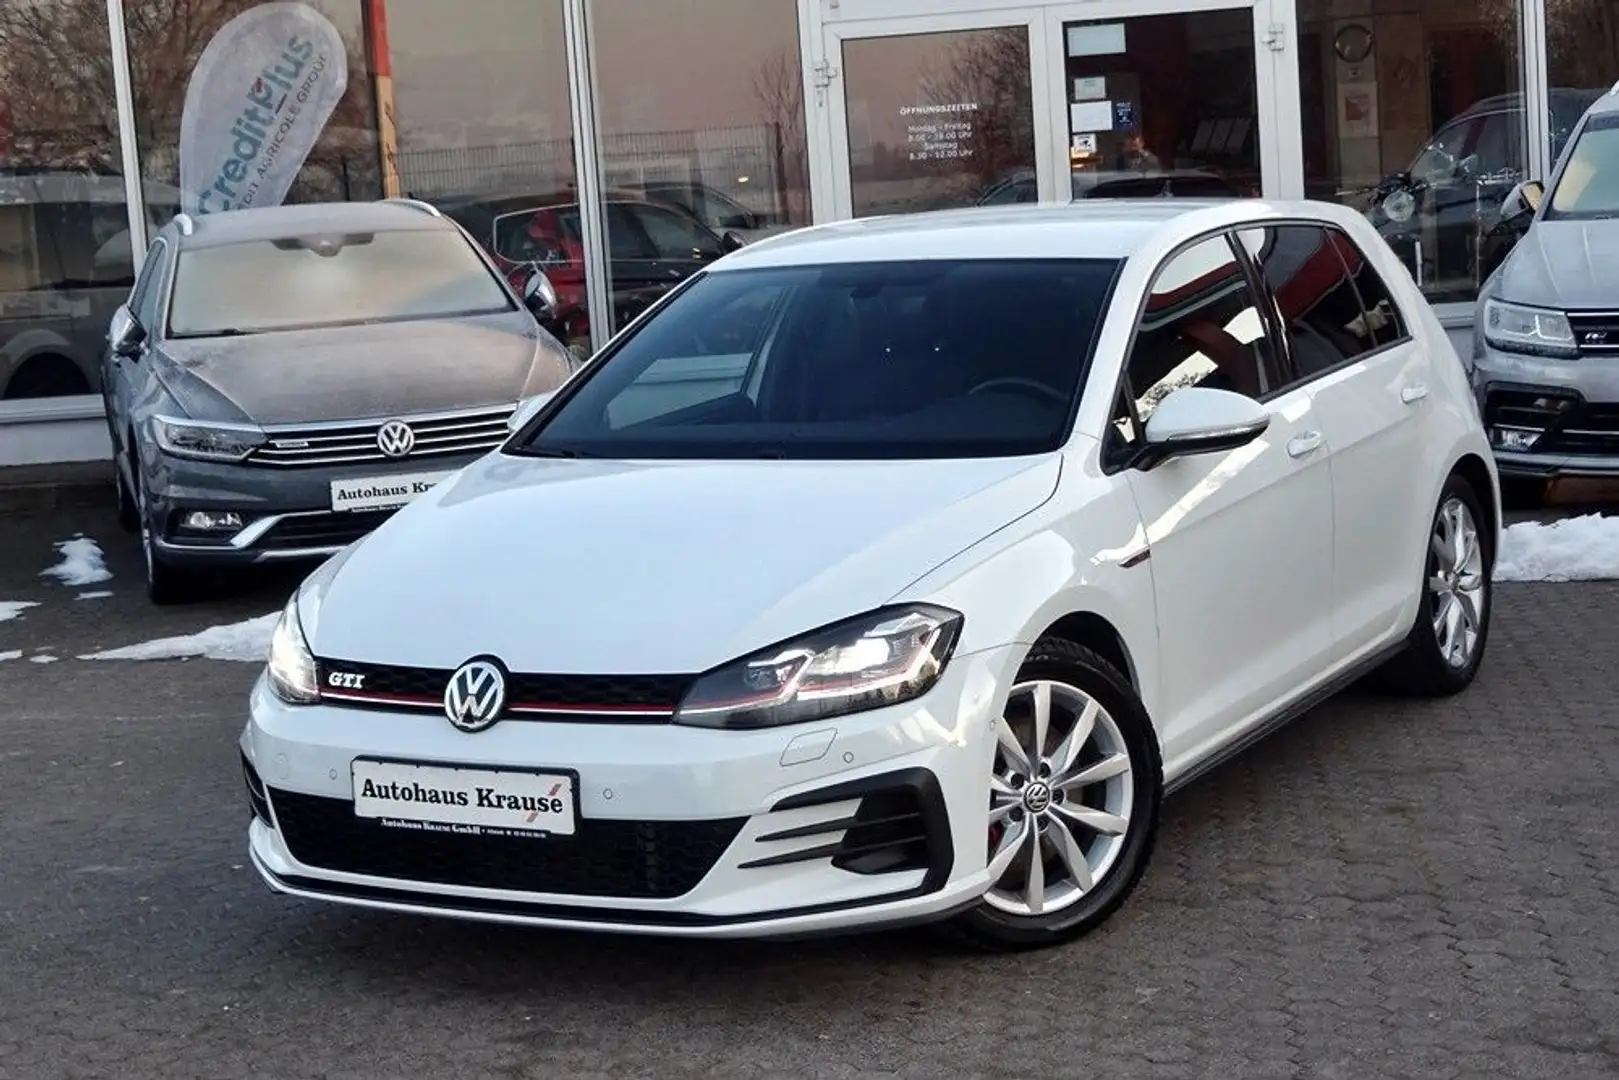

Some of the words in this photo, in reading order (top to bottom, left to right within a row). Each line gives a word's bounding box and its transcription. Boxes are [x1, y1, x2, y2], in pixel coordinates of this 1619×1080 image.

[337, 485, 409, 501] Autohaus
[328, 671, 366, 689] GTI
[361, 778, 470, 807] Autohaus
[475, 787, 565, 814] Krause
